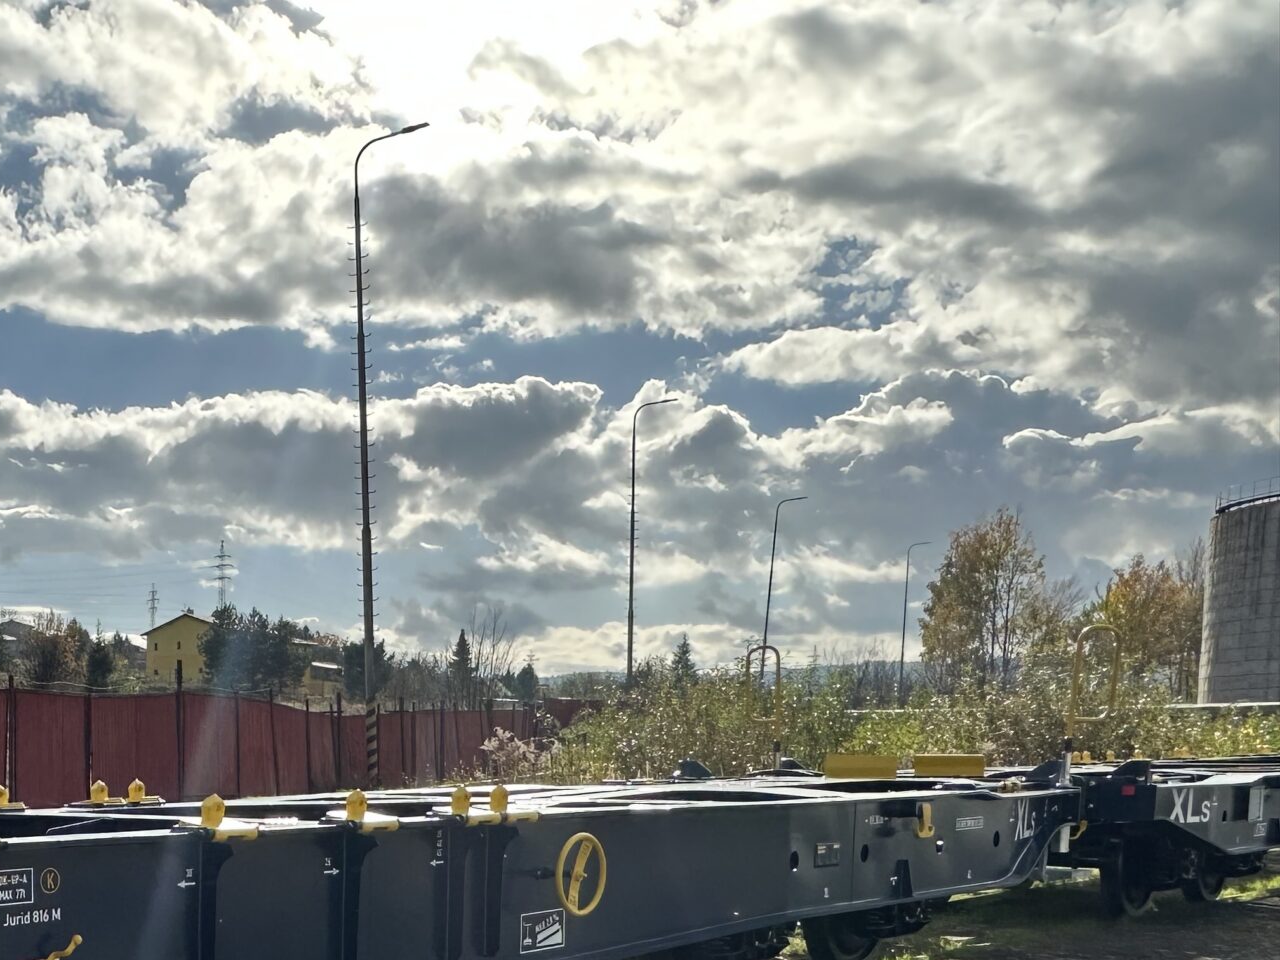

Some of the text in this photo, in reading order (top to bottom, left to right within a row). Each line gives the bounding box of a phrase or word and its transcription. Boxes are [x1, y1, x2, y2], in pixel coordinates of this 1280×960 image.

[1170, 788, 1211, 824] XLs
[47, 871, 55, 889] K
[3, 907, 61, 927] Jurid 816 M
